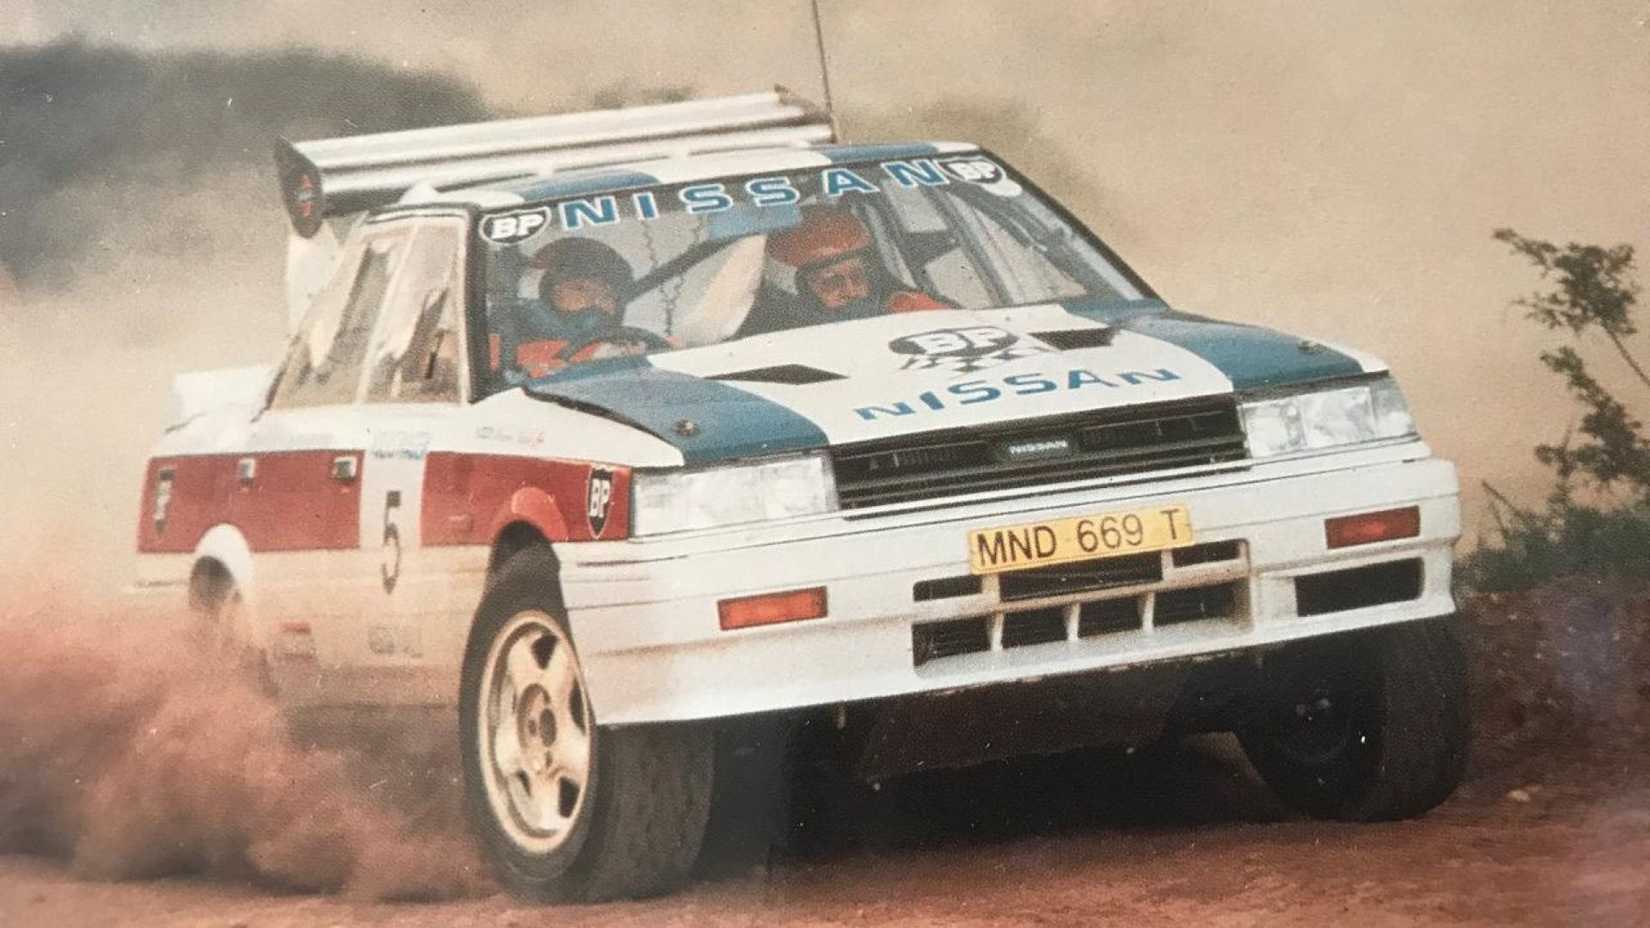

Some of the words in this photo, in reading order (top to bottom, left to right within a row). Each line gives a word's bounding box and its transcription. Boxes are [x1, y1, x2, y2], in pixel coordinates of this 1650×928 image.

[947, 160, 998, 181] BP
[558, 158, 950, 231] NISSAN
[490, 203, 545, 240] BP
[911, 328, 1008, 356] BP
[854, 368, 1180, 420] NISSAN
[589, 478, 611, 518] BP
[381, 490, 402, 595] 5
[976, 525, 1057, 567] MND
[1076, 514, 1143, 552] 669
[1160, 508, 1180, 541] T
